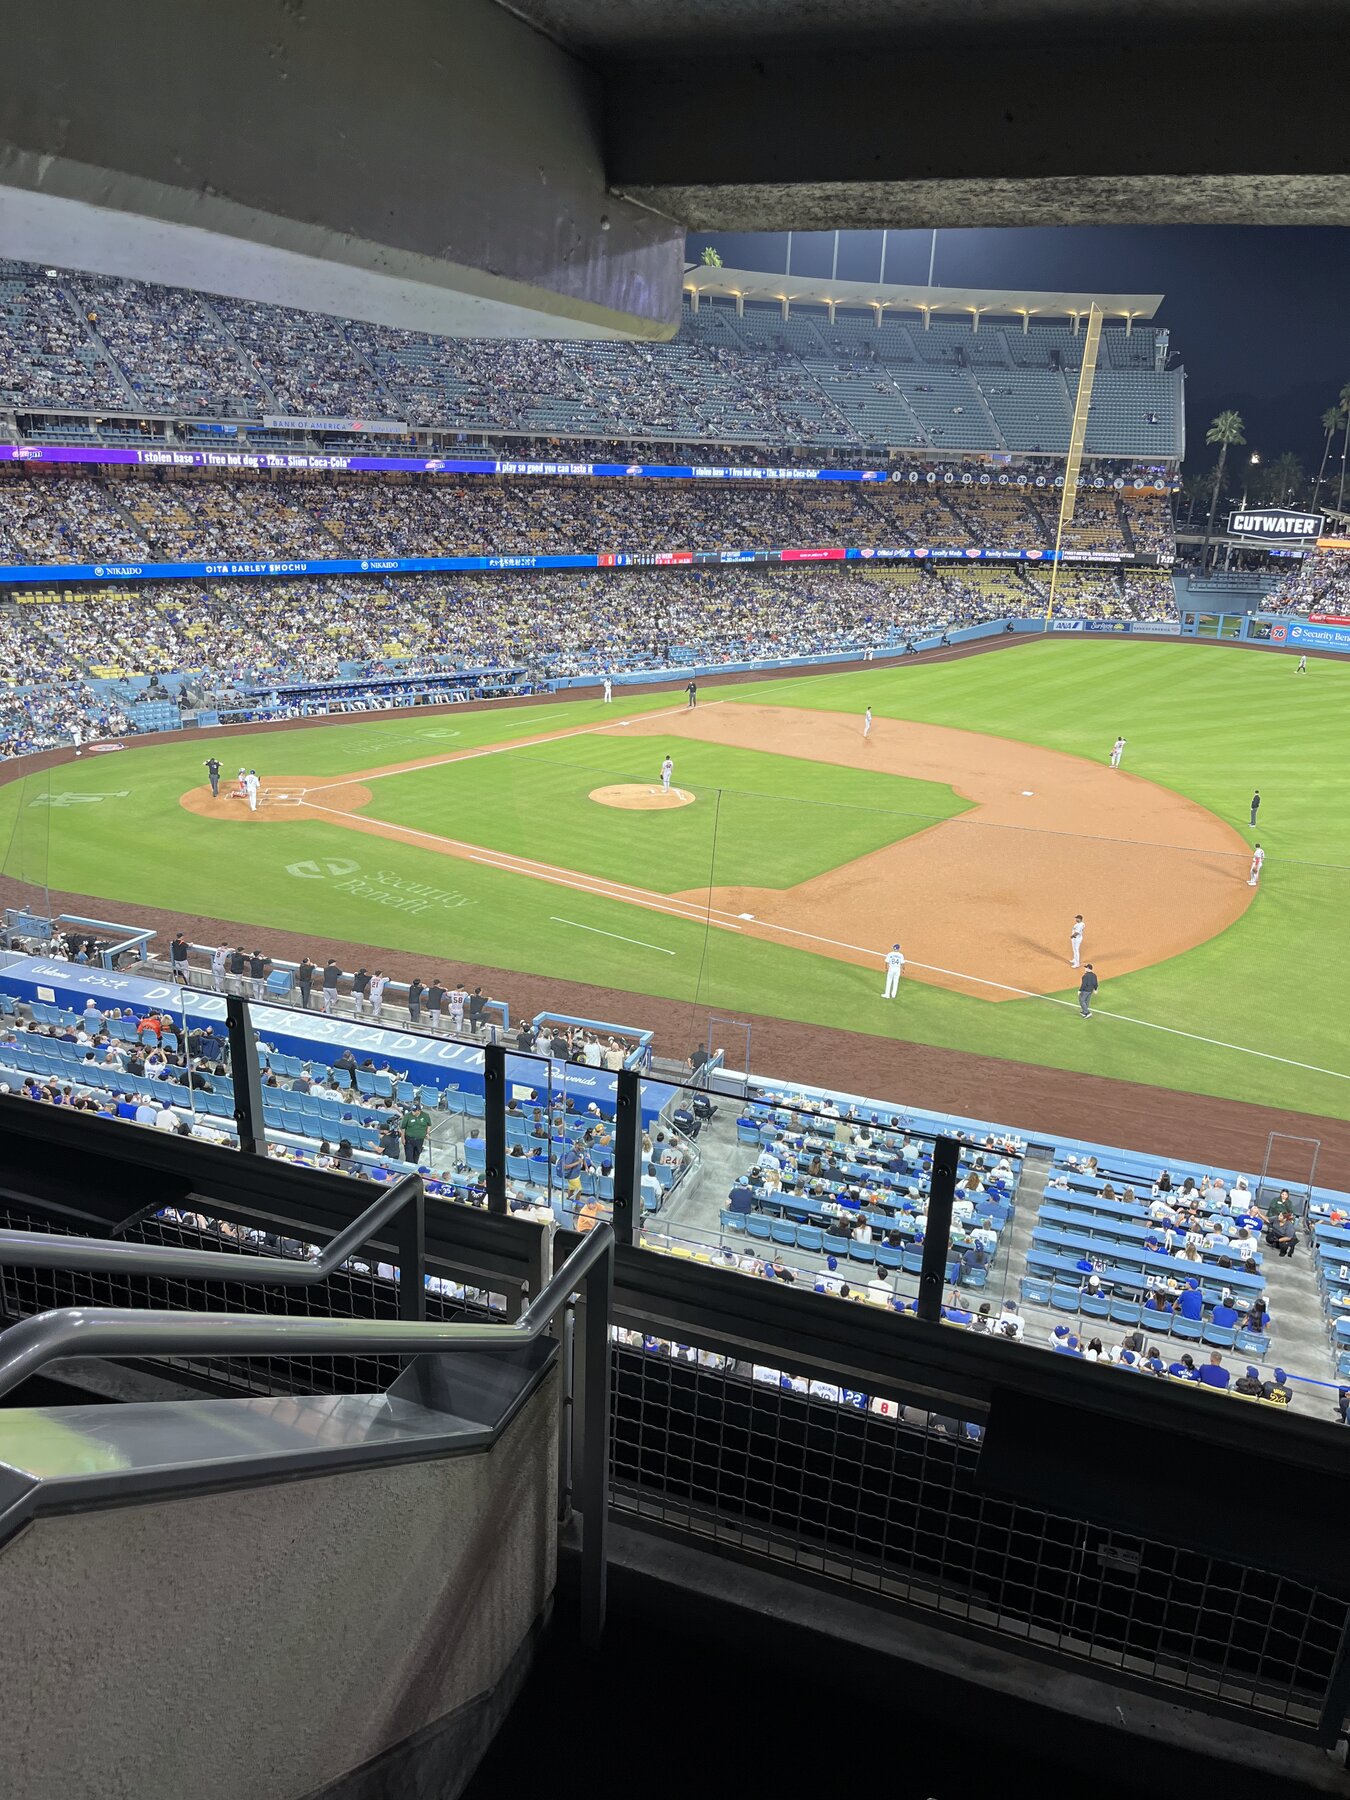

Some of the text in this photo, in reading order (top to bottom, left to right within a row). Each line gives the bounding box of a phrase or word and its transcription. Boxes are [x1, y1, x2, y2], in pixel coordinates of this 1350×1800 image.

[310, 422, 346, 430] AMERICA
[144, 452, 172, 462] stolen
[174, 454, 193, 463] base
[209, 454, 226, 464] free
[227, 454, 241, 465] hot
[243, 455, 258, 467] dog
[502, 463, 517, 474] play
[527, 463, 543, 474] good
[544, 465, 557, 474] you
[571, 464, 586, 474] taste
[587, 464, 593, 474] it
[1234, 516, 1314, 534] CUTWATER
[231, 564, 266, 573] BARLEY
[269, 564, 307, 572] SHOCHU
[1274, 629, 1286, 638] 76
[1303, 628, 1350, 641] Security Ben
[364, 870, 478, 908] Security
[334, 879, 436, 915] Benefit
[144, 987, 298, 1025] DODER
[666, 1156, 677, 1164] 24
[827, 1282, 833, 1290] 5
[845, 1391, 862, 1407] 22
[880, 1402, 888, 1414] 8
